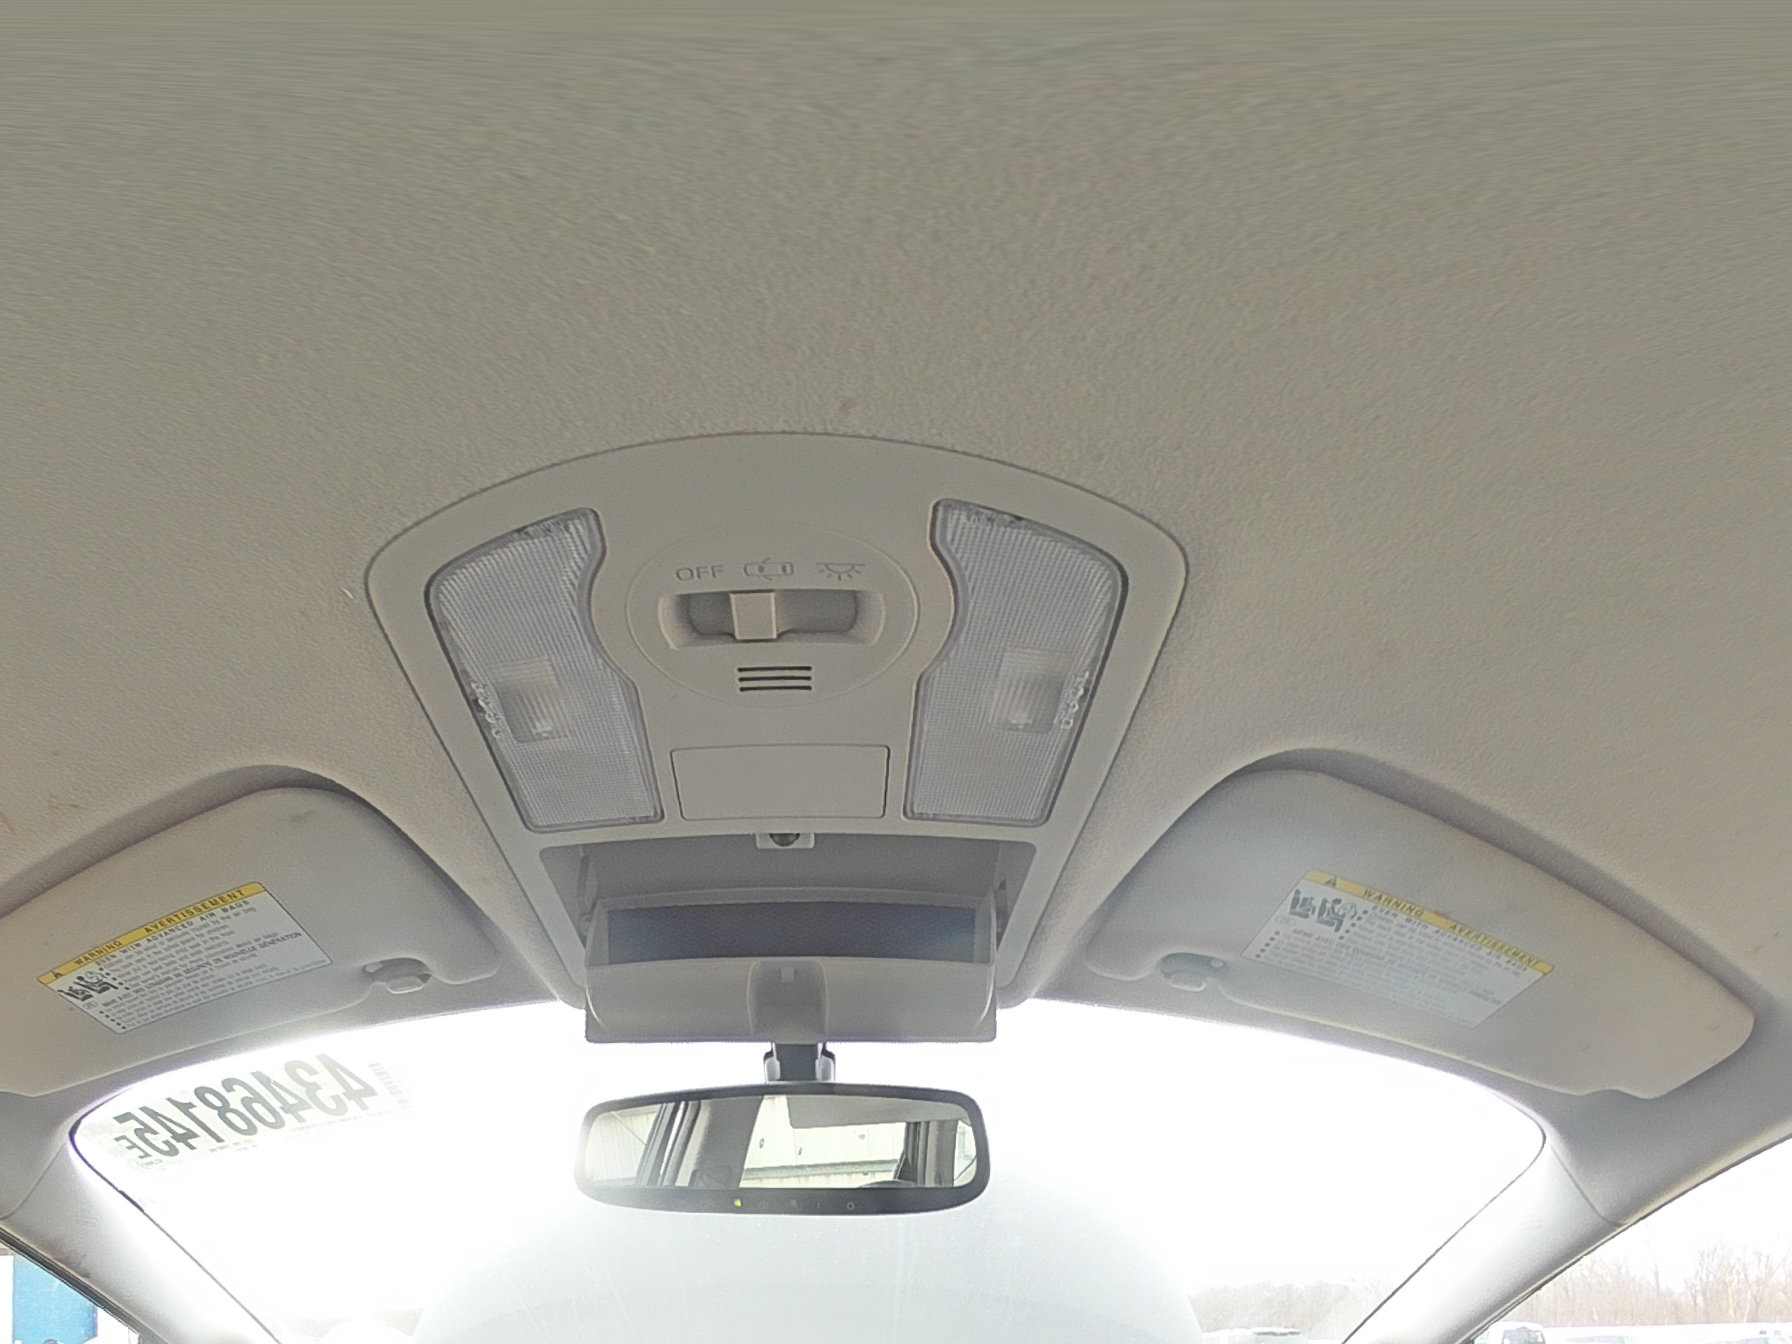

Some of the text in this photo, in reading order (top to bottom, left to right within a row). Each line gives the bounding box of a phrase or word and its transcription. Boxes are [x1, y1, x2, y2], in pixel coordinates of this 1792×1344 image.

[675, 564, 725, 582] OFF
[1363, 888, 1423, 918] WARNING
[73, 889, 246, 966] WARNING AVERTISSEMENT
